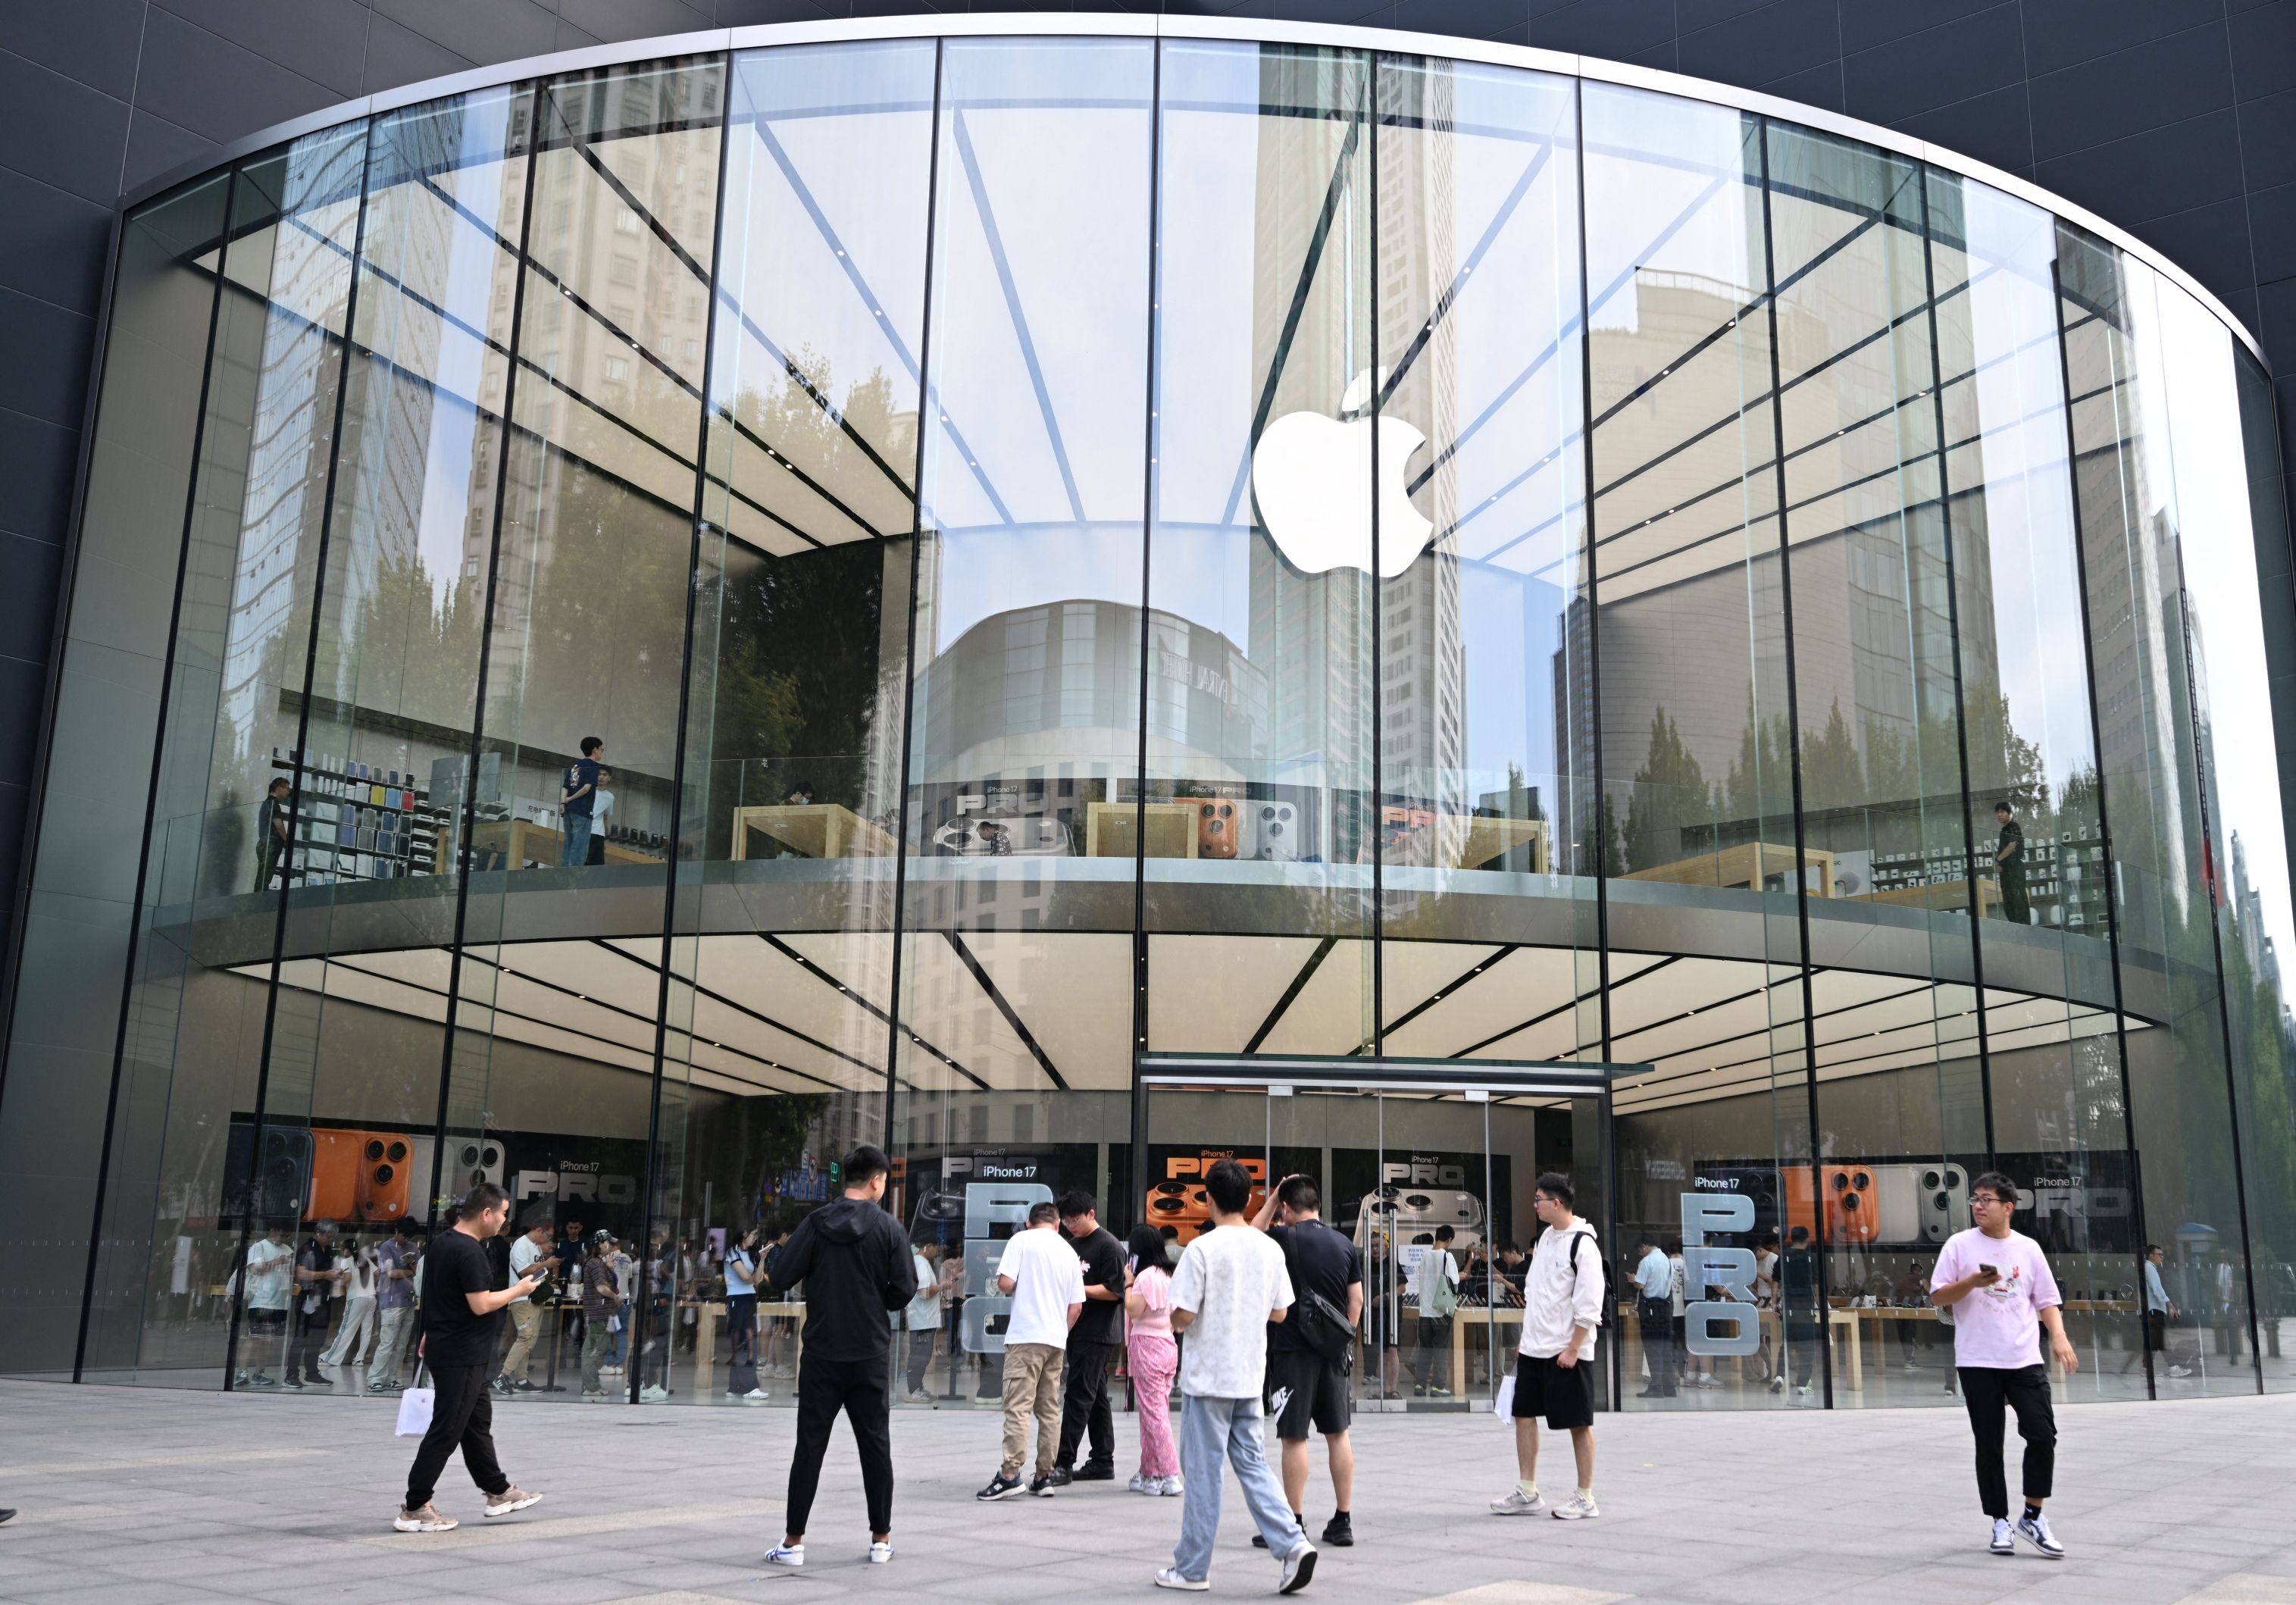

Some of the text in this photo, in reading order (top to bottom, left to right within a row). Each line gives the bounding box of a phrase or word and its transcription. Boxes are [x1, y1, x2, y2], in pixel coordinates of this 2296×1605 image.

[956, 794, 1050, 815] PRO
[1381, 806, 1437, 828] PR
[560, 1160, 599, 1171] iPhone 17
[984, 1166, 1037, 1177] iPhone 17
[1383, 1162, 1465, 1185] PRO
[517, 1169, 637, 1204] PRO
[1694, 1177, 1740, 1188] iPhone 17
[2034, 1177, 2081, 1187] iPhone 17
[1681, 1192, 1760, 1356] PRO
